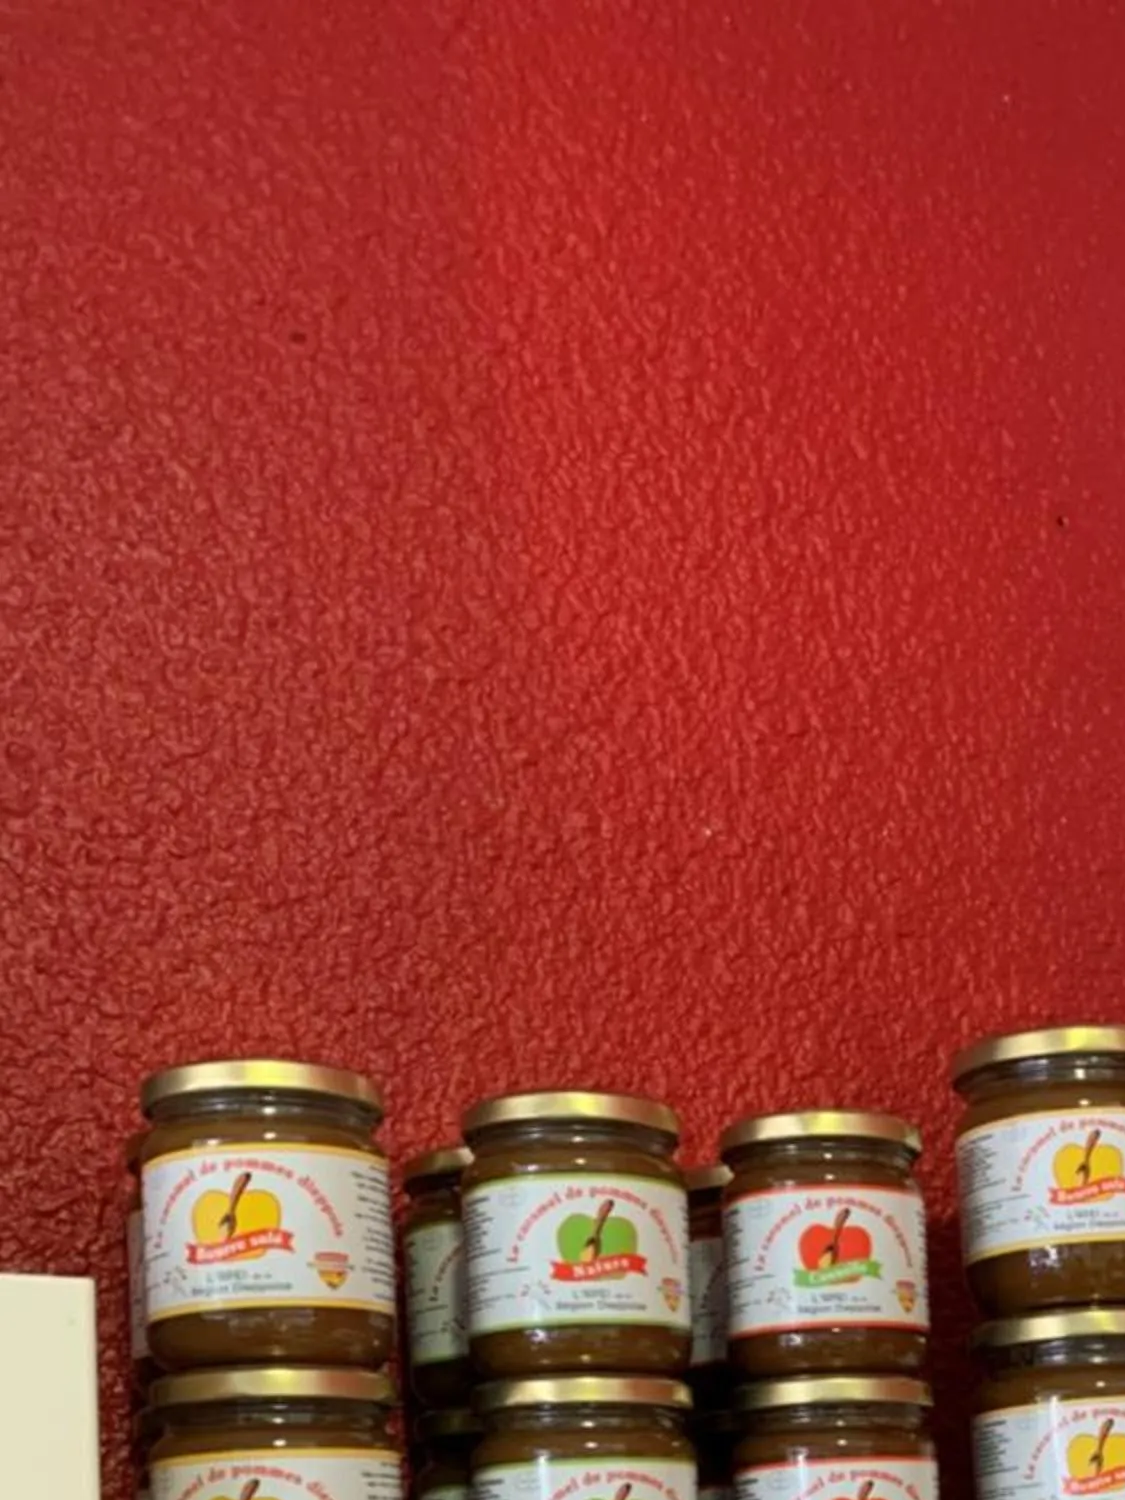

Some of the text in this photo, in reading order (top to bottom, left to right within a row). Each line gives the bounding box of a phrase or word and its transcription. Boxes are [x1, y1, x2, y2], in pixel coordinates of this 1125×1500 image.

[160, 1170, 196, 1224] caramel
[200, 1160, 217, 1174] de
[572, 1259, 630, 1278] Nature
[208, 1467, 225, 1482] de
